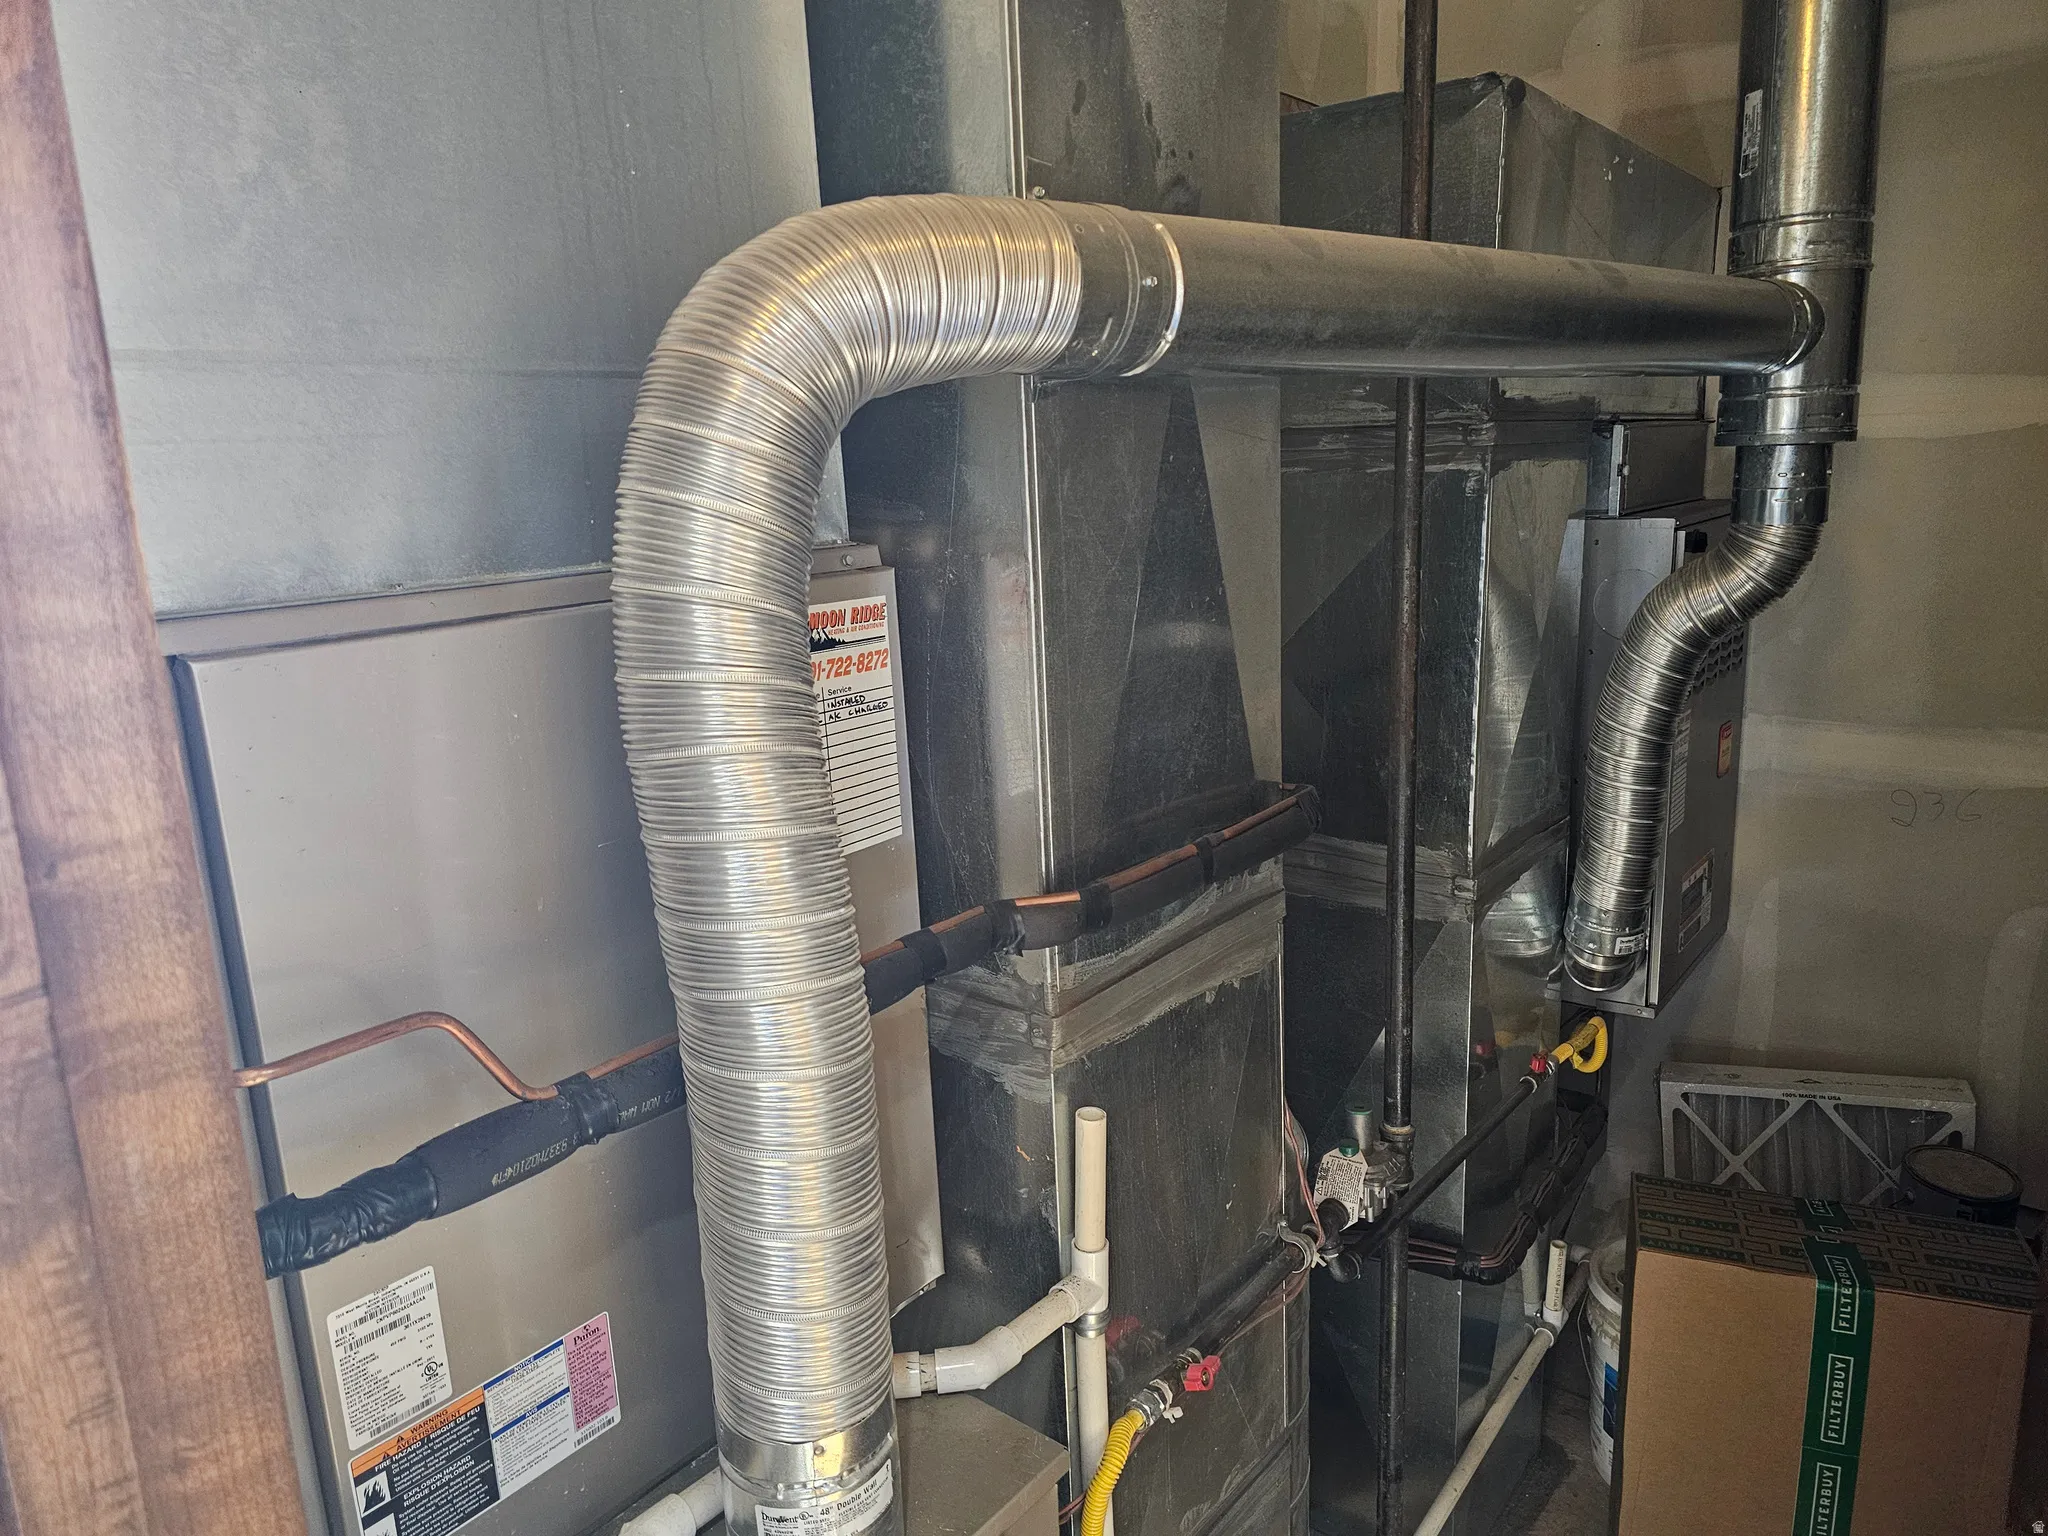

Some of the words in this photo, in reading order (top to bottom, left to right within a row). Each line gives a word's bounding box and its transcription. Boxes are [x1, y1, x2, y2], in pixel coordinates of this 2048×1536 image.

[850, 602, 887, 625] RIDGE
[858, 621, 885, 631] CONDITIONING
[811, 648, 889, 682] 01-722-8272
[827, 686, 852, 696] Service
[848, 701, 889, 716] CHARGED
[1832, 1258, 1850, 1328] FILTERBUY
[573, 1328, 601, 1346] Puron
[524, 1406, 537, 1418] AVIS
[1828, 1360, 1847, 1439] FILTERBUY
[395, 1408, 461, 1452] AVERTISSEMENT
[410, 1407, 448, 1435] WARNING
[374, 1457, 392, 1472] FIRE
[392, 1440, 421, 1461] HAZARD
[429, 1420, 455, 1440] RISQUE
[456, 1413, 466, 1423] DE
[466, 1405, 480, 1418] FEU
[403, 1472, 442, 1500] EXPLOSION
[443, 1454, 470, 1475] HAZARD
[403, 1486, 430, 1507] RISQUE
[430, 1459, 474, 1490] D'EXPLOSION
[836, 1492, 862, 1511] Double
[863, 1479, 878, 1495] Wall
[1816, 1469, 1834, 1536] ILTERBUY
